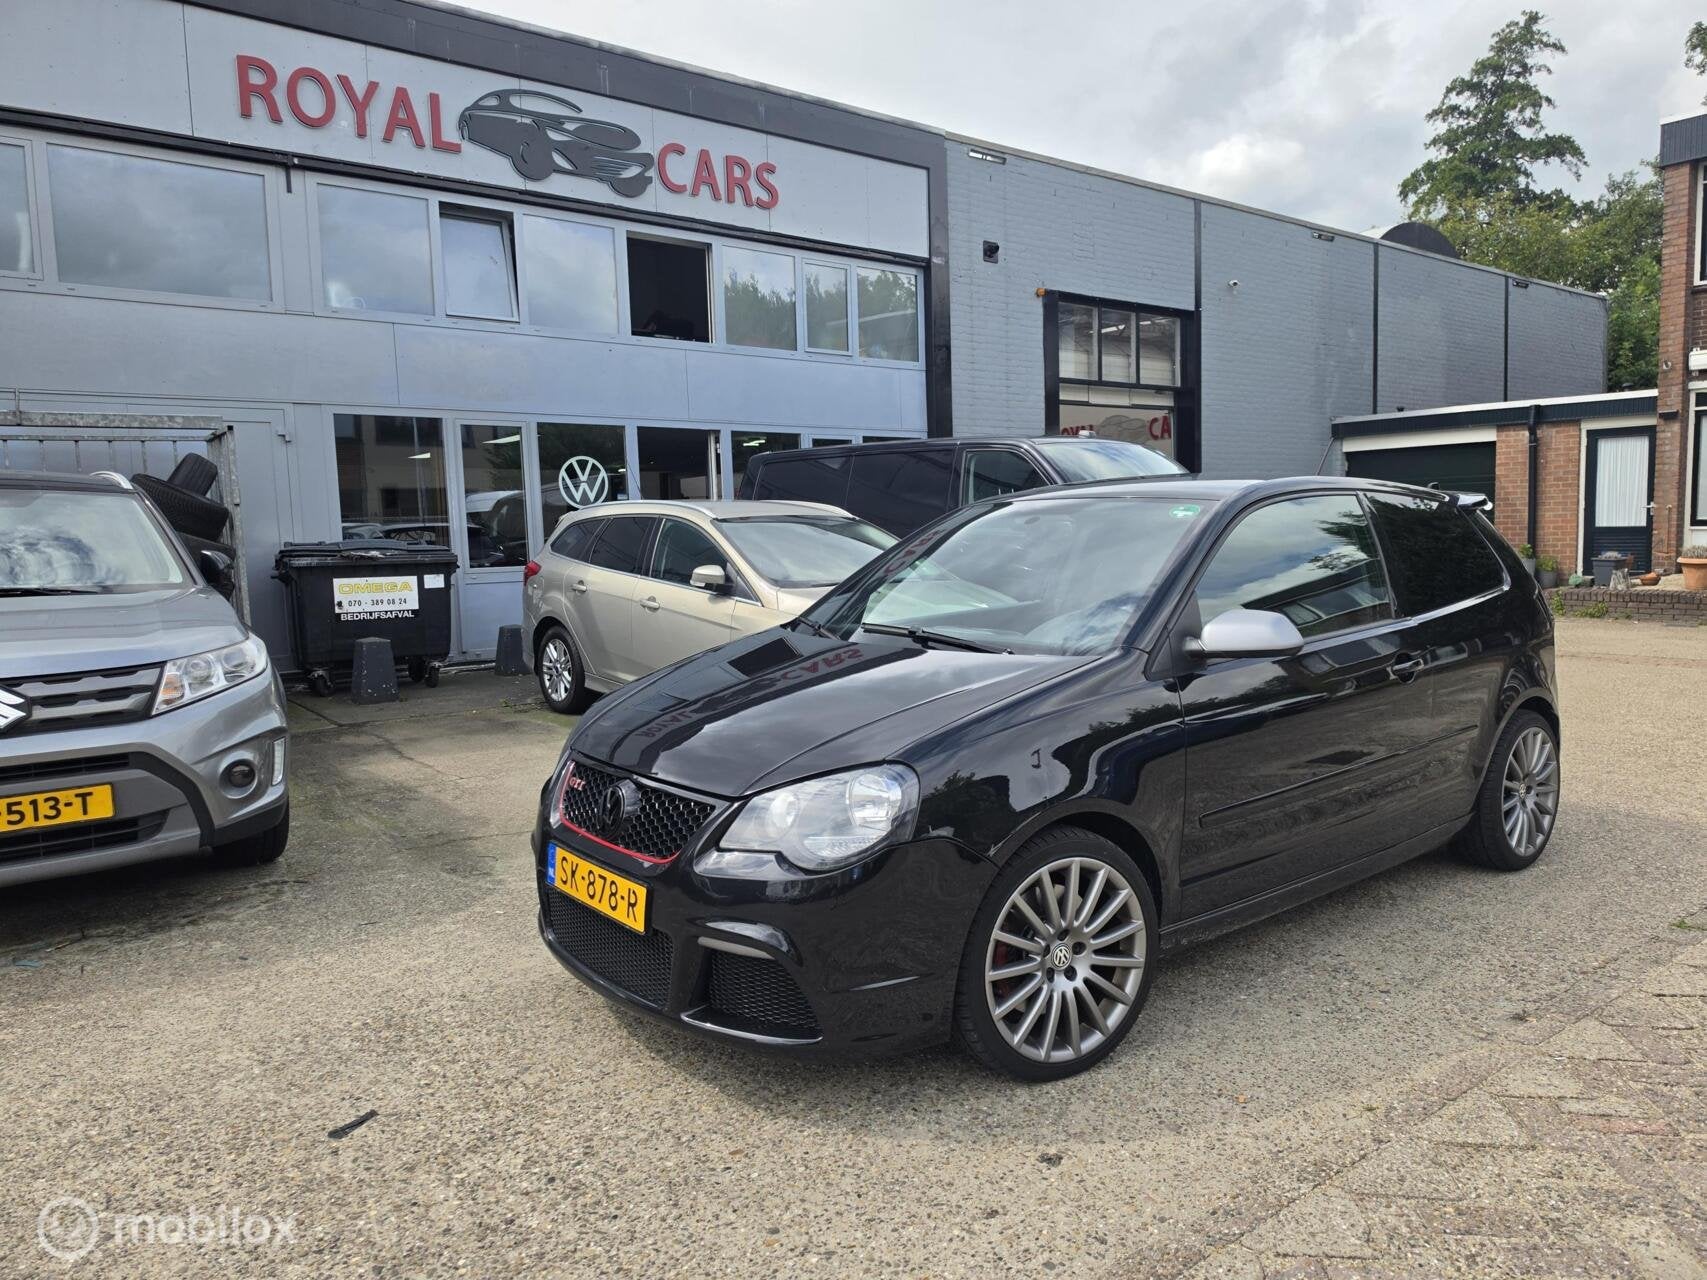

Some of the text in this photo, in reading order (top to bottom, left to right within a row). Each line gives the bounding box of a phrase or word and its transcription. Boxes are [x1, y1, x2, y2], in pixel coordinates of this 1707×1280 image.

[235, 54, 780, 210] ROYAL CARS
[339, 582, 412, 595] OMEGA
[370, 598, 384, 606] 389
[340, 610, 415, 621] BEDRIJFSAFVAL
[0, 791, 93, 826] 513-T
[559, 856, 638, 923] SK-878-R
